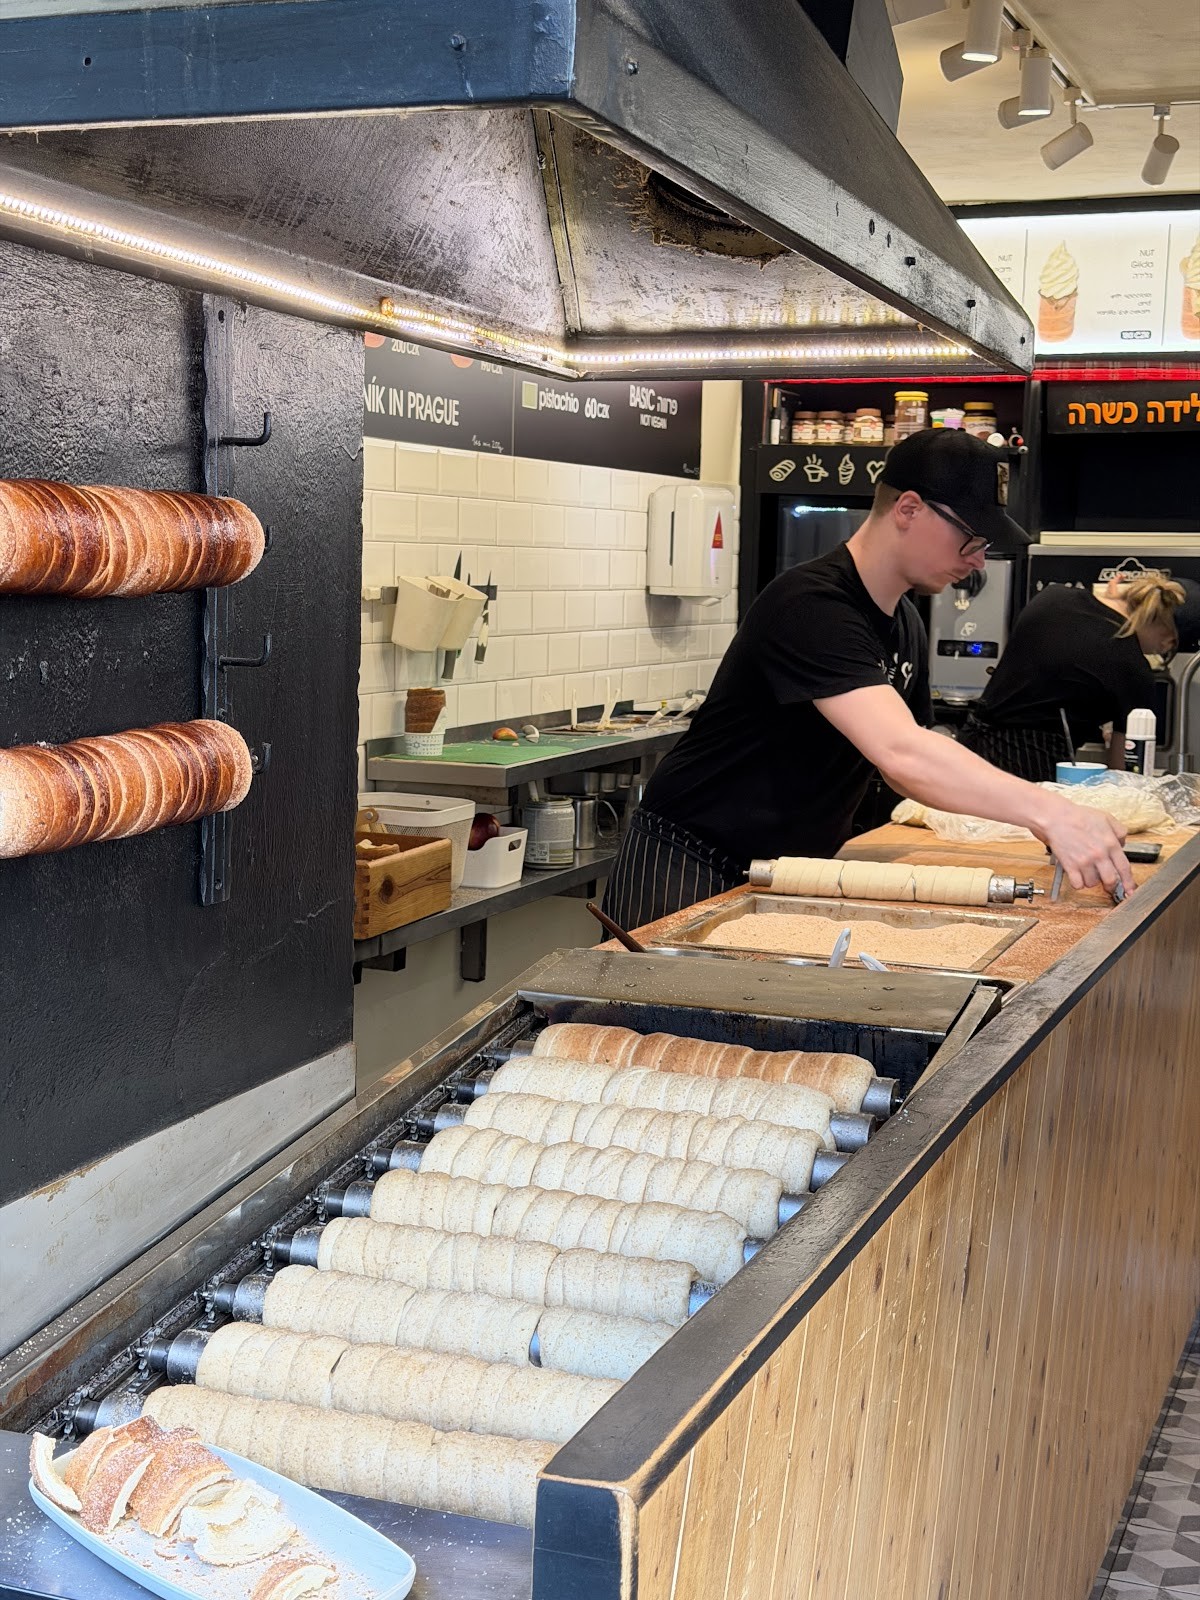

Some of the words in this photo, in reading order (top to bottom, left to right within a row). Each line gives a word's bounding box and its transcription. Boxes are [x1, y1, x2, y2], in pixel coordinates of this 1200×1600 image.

[388, 387, 404, 418] IN
[407, 391, 459, 426] PRAGUE
[538, 387, 580, 414] pistachio
[629, 385, 655, 410] BASIC
[1068, 401, 1138, 424] כשרה
